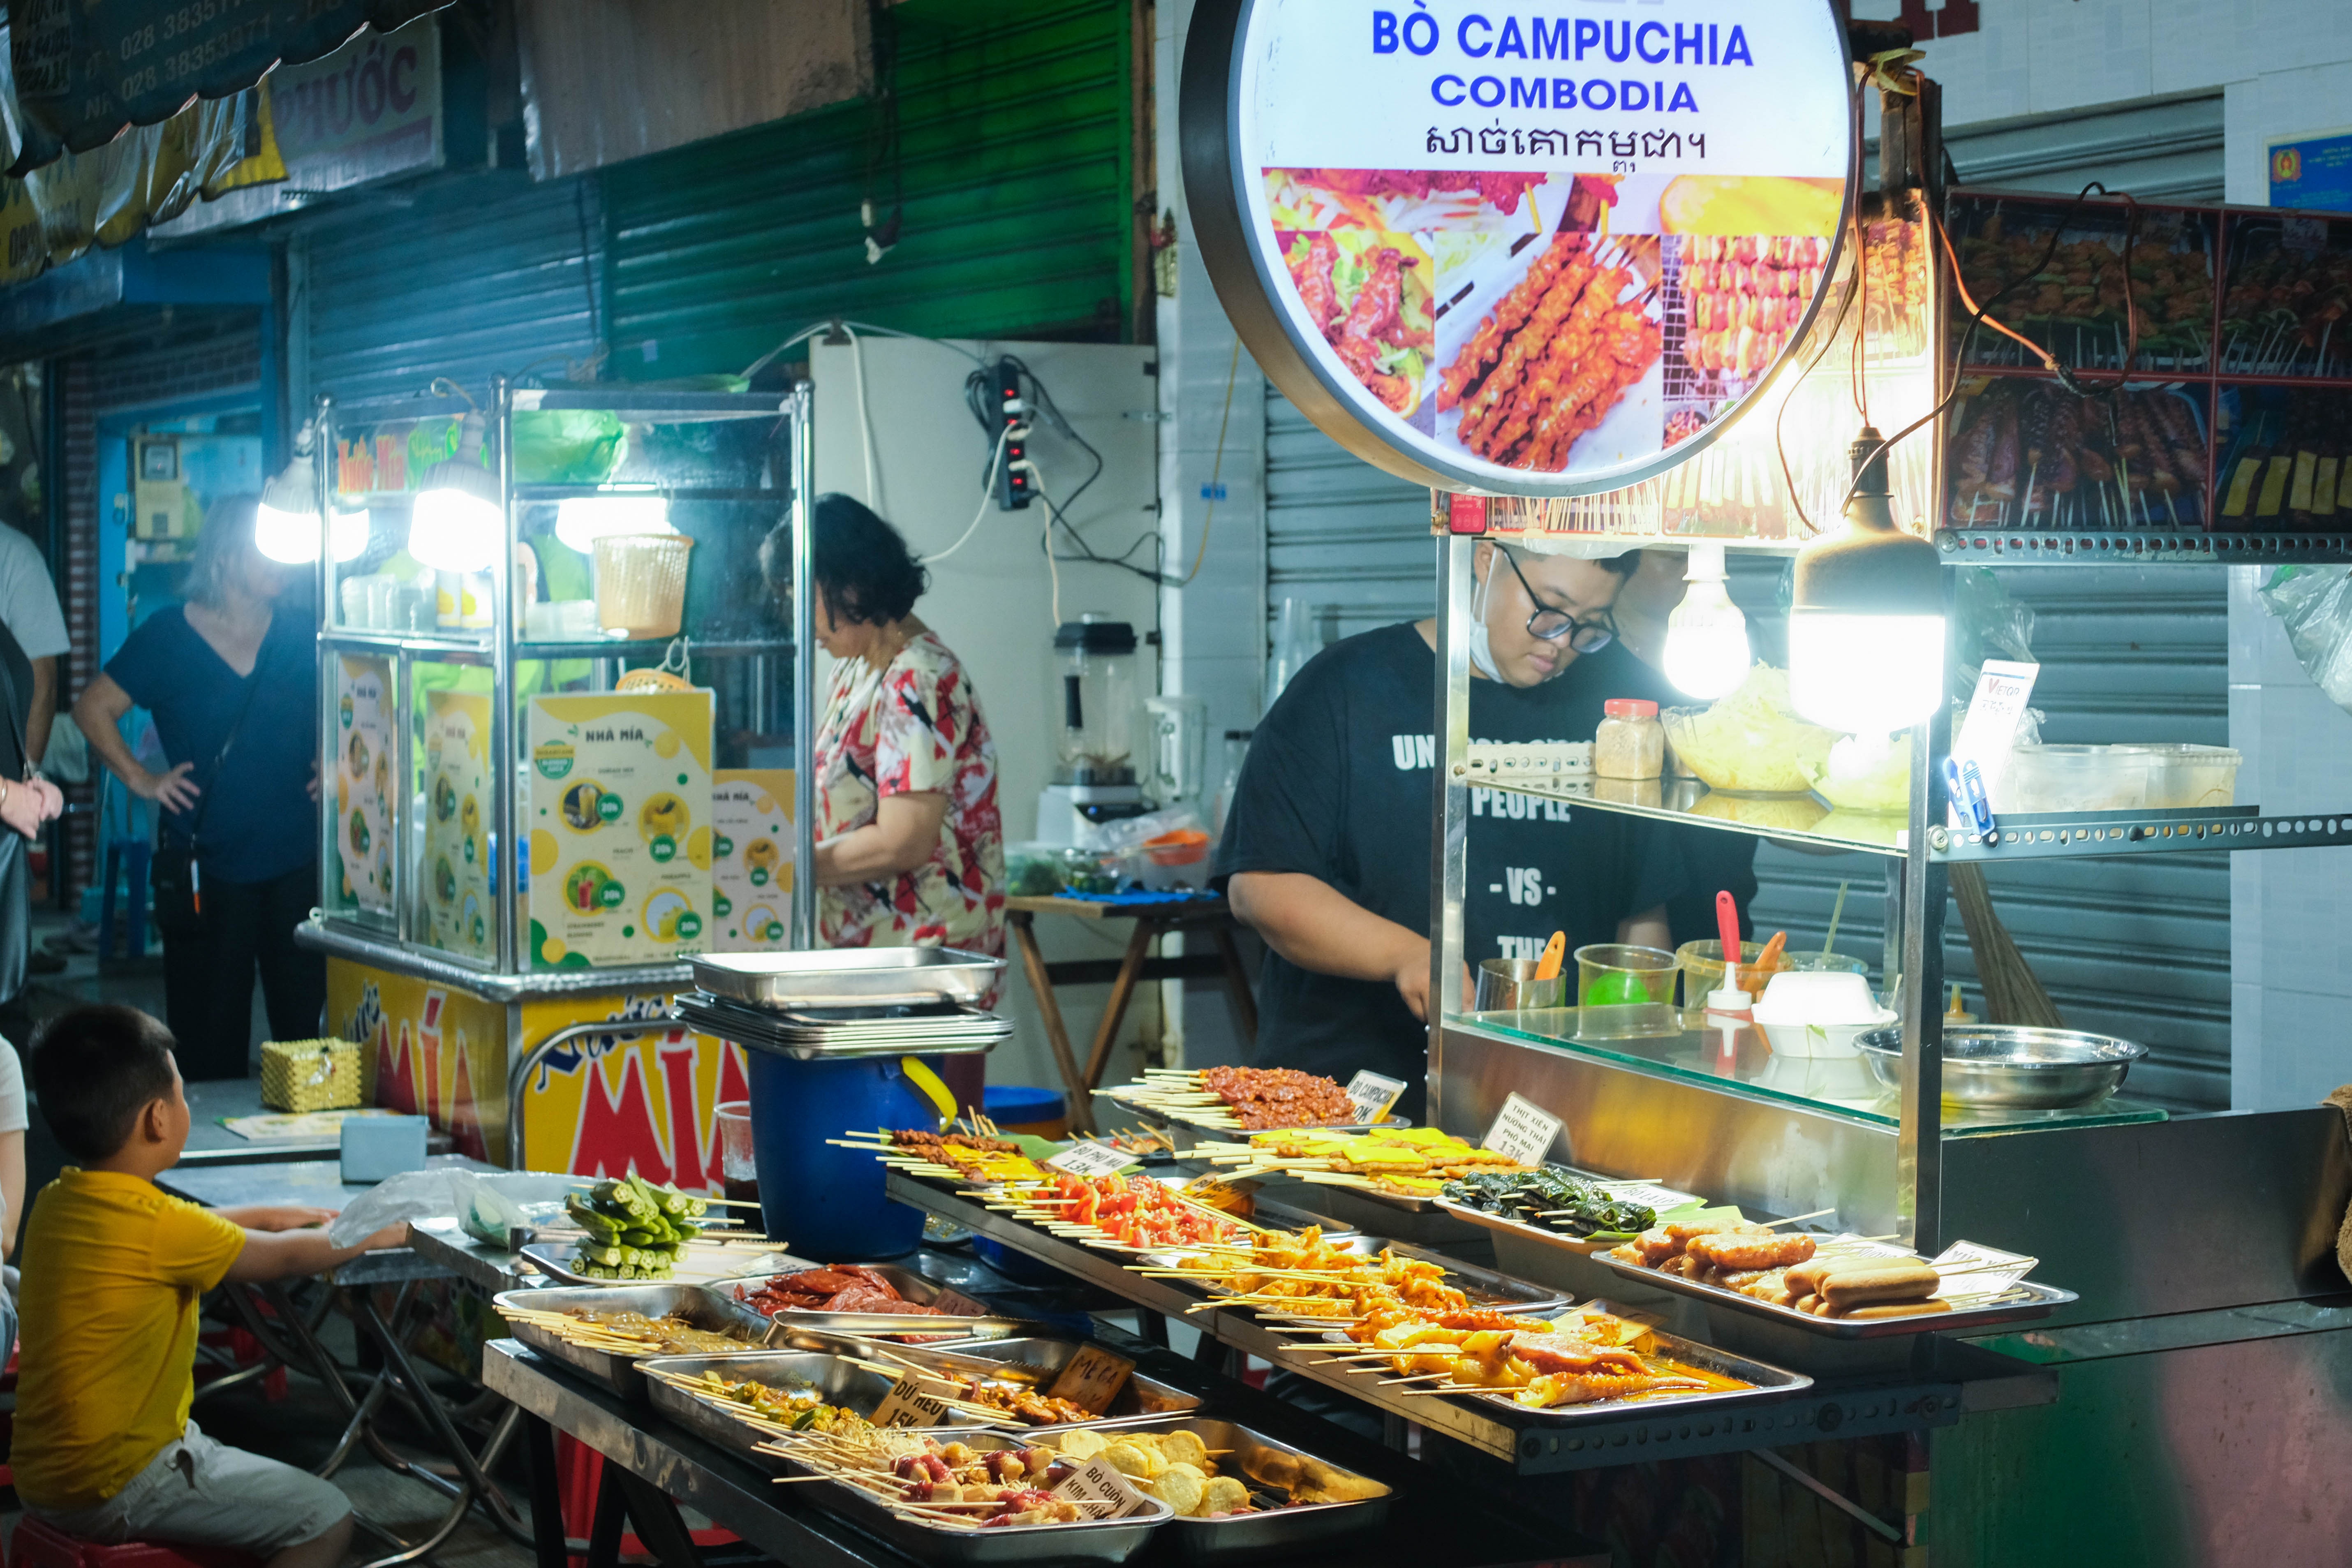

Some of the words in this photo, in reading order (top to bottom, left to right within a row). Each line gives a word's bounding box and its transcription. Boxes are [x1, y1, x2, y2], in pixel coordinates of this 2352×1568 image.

[1373, 0, 1439, 56] BÒ
[1457, 14, 1754, 67] CAMPUCHIA
[1431, 74, 1699, 113] COMBODIA
[585, 725, 615, 743] NHÀ
[620, 725, 645, 741] MÍA
[1353, 1105, 1374, 1122] 0K
[1512, 1105, 1530, 1119] THỊT
[1519, 1139, 1535, 1152] MAI
[1085, 1466, 1105, 1484] BÒ
[1065, 1478, 1087, 1501] KIM
